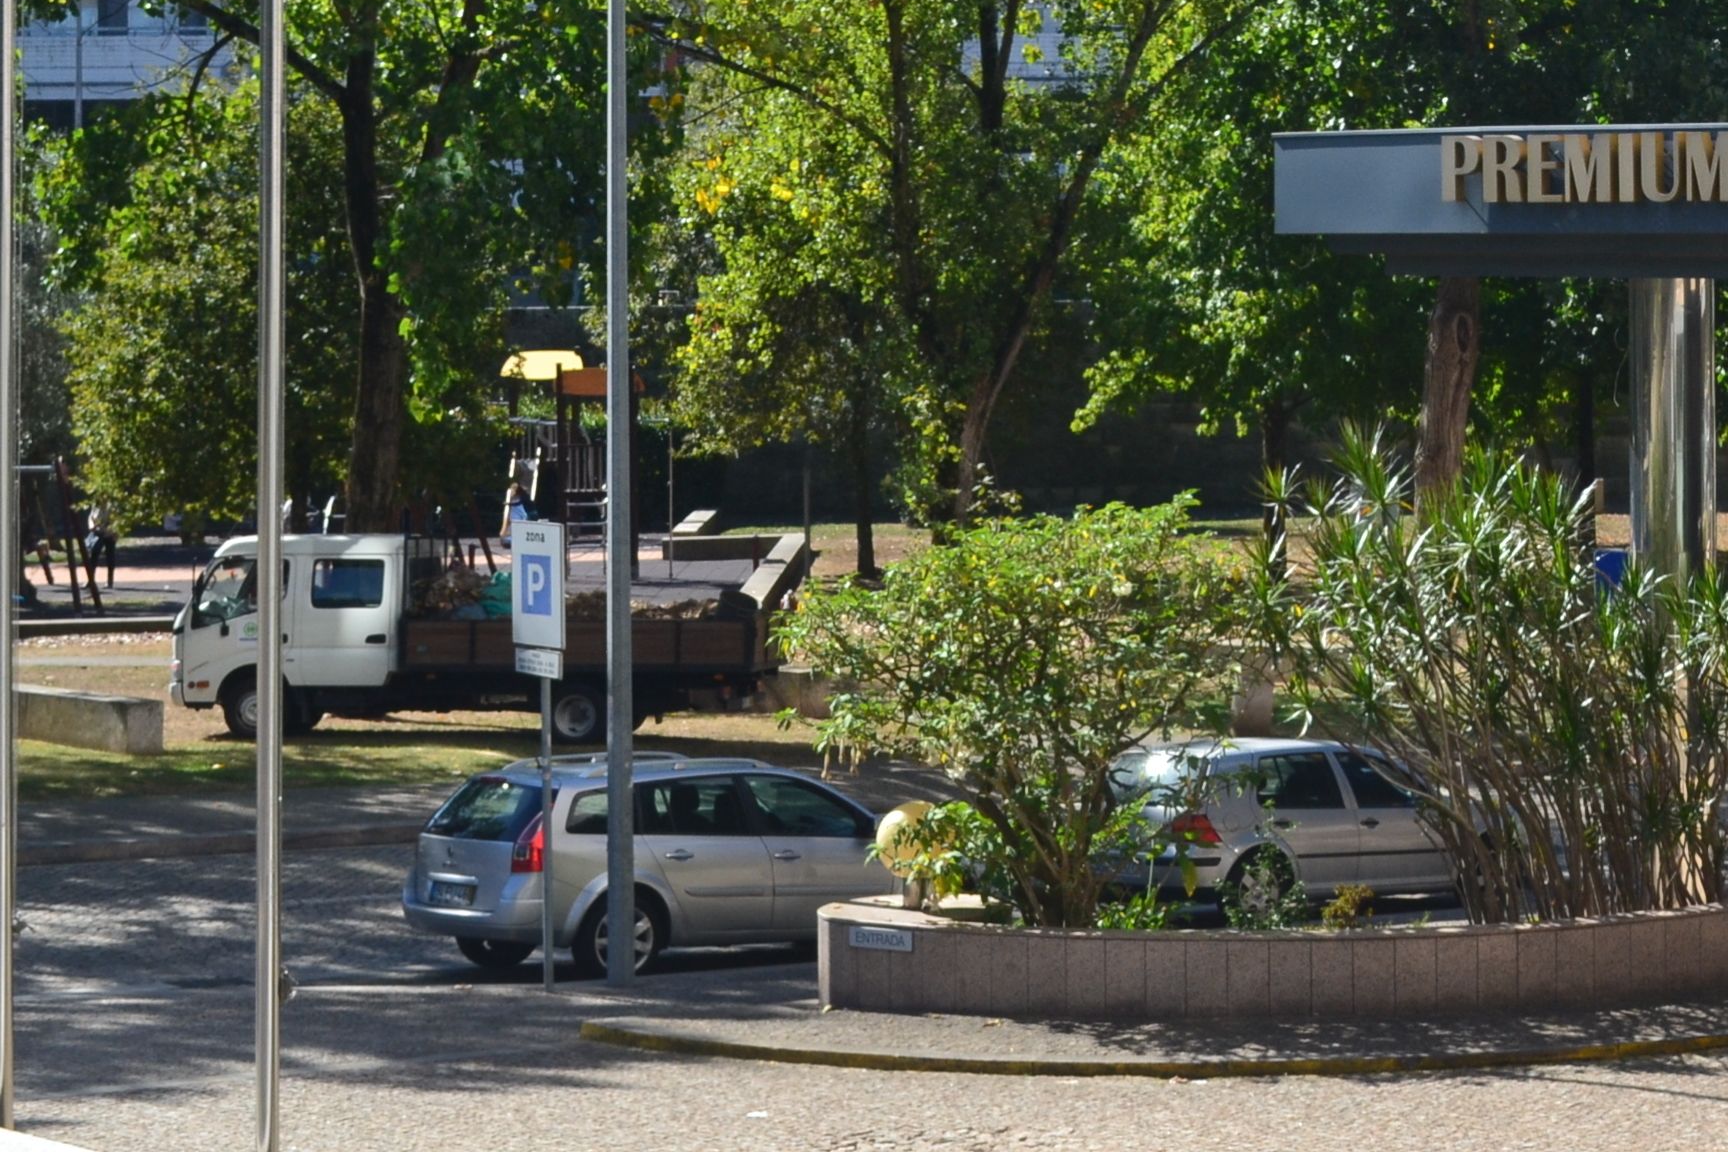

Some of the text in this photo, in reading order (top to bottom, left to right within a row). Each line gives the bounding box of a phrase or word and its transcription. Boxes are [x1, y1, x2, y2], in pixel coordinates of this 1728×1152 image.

[525, 531, 545, 543] zona
[527, 562, 545, 606] P
[855, 931, 905, 947] ENTRADA
